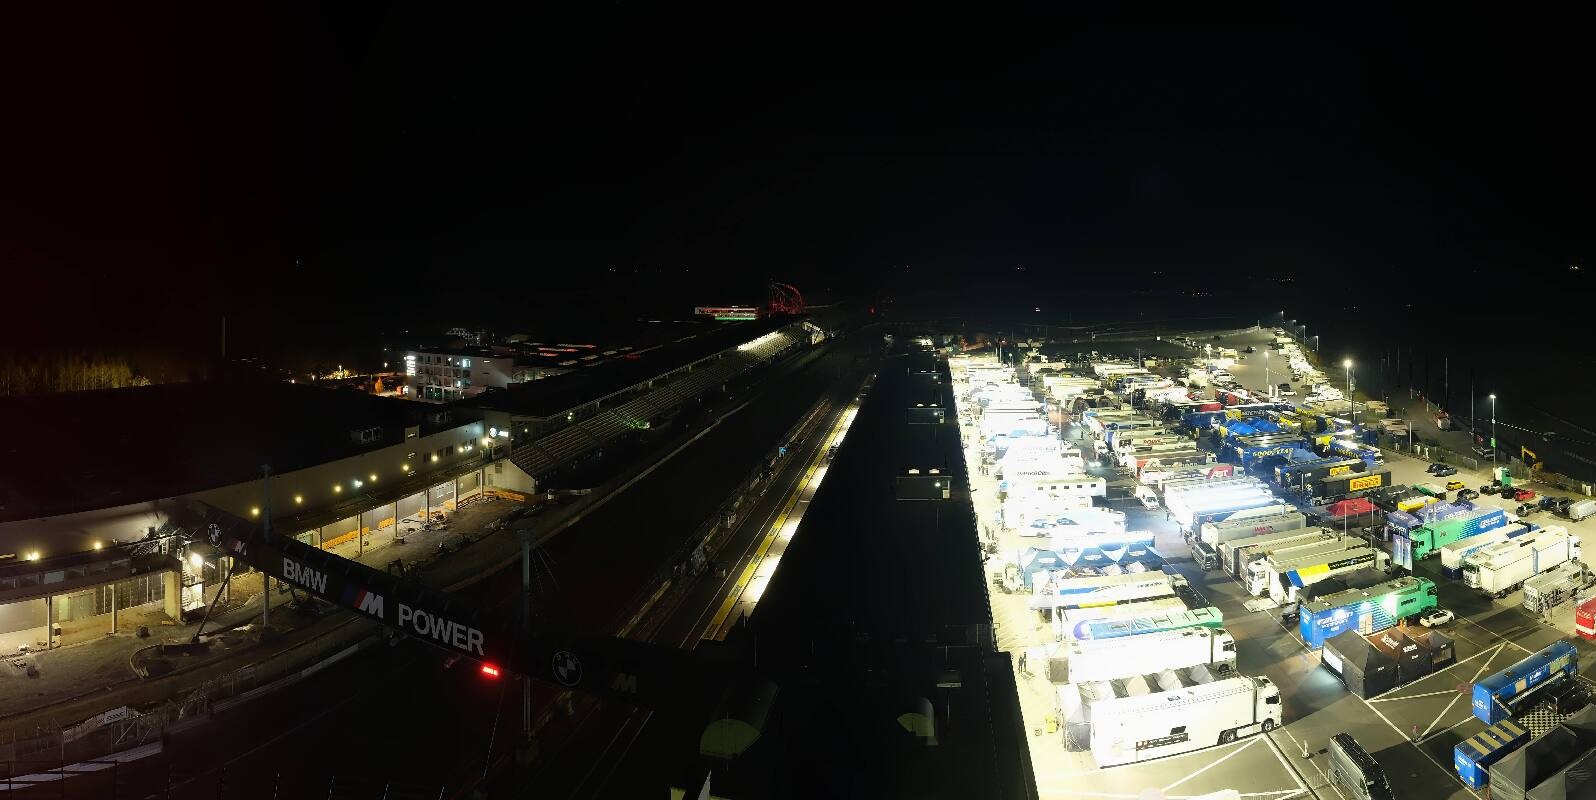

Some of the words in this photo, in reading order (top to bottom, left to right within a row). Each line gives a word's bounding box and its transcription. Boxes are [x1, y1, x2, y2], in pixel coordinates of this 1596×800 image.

[282, 557, 329, 594] BMW
[358, 591, 384, 619] M
[398, 601, 486, 656] POWER
